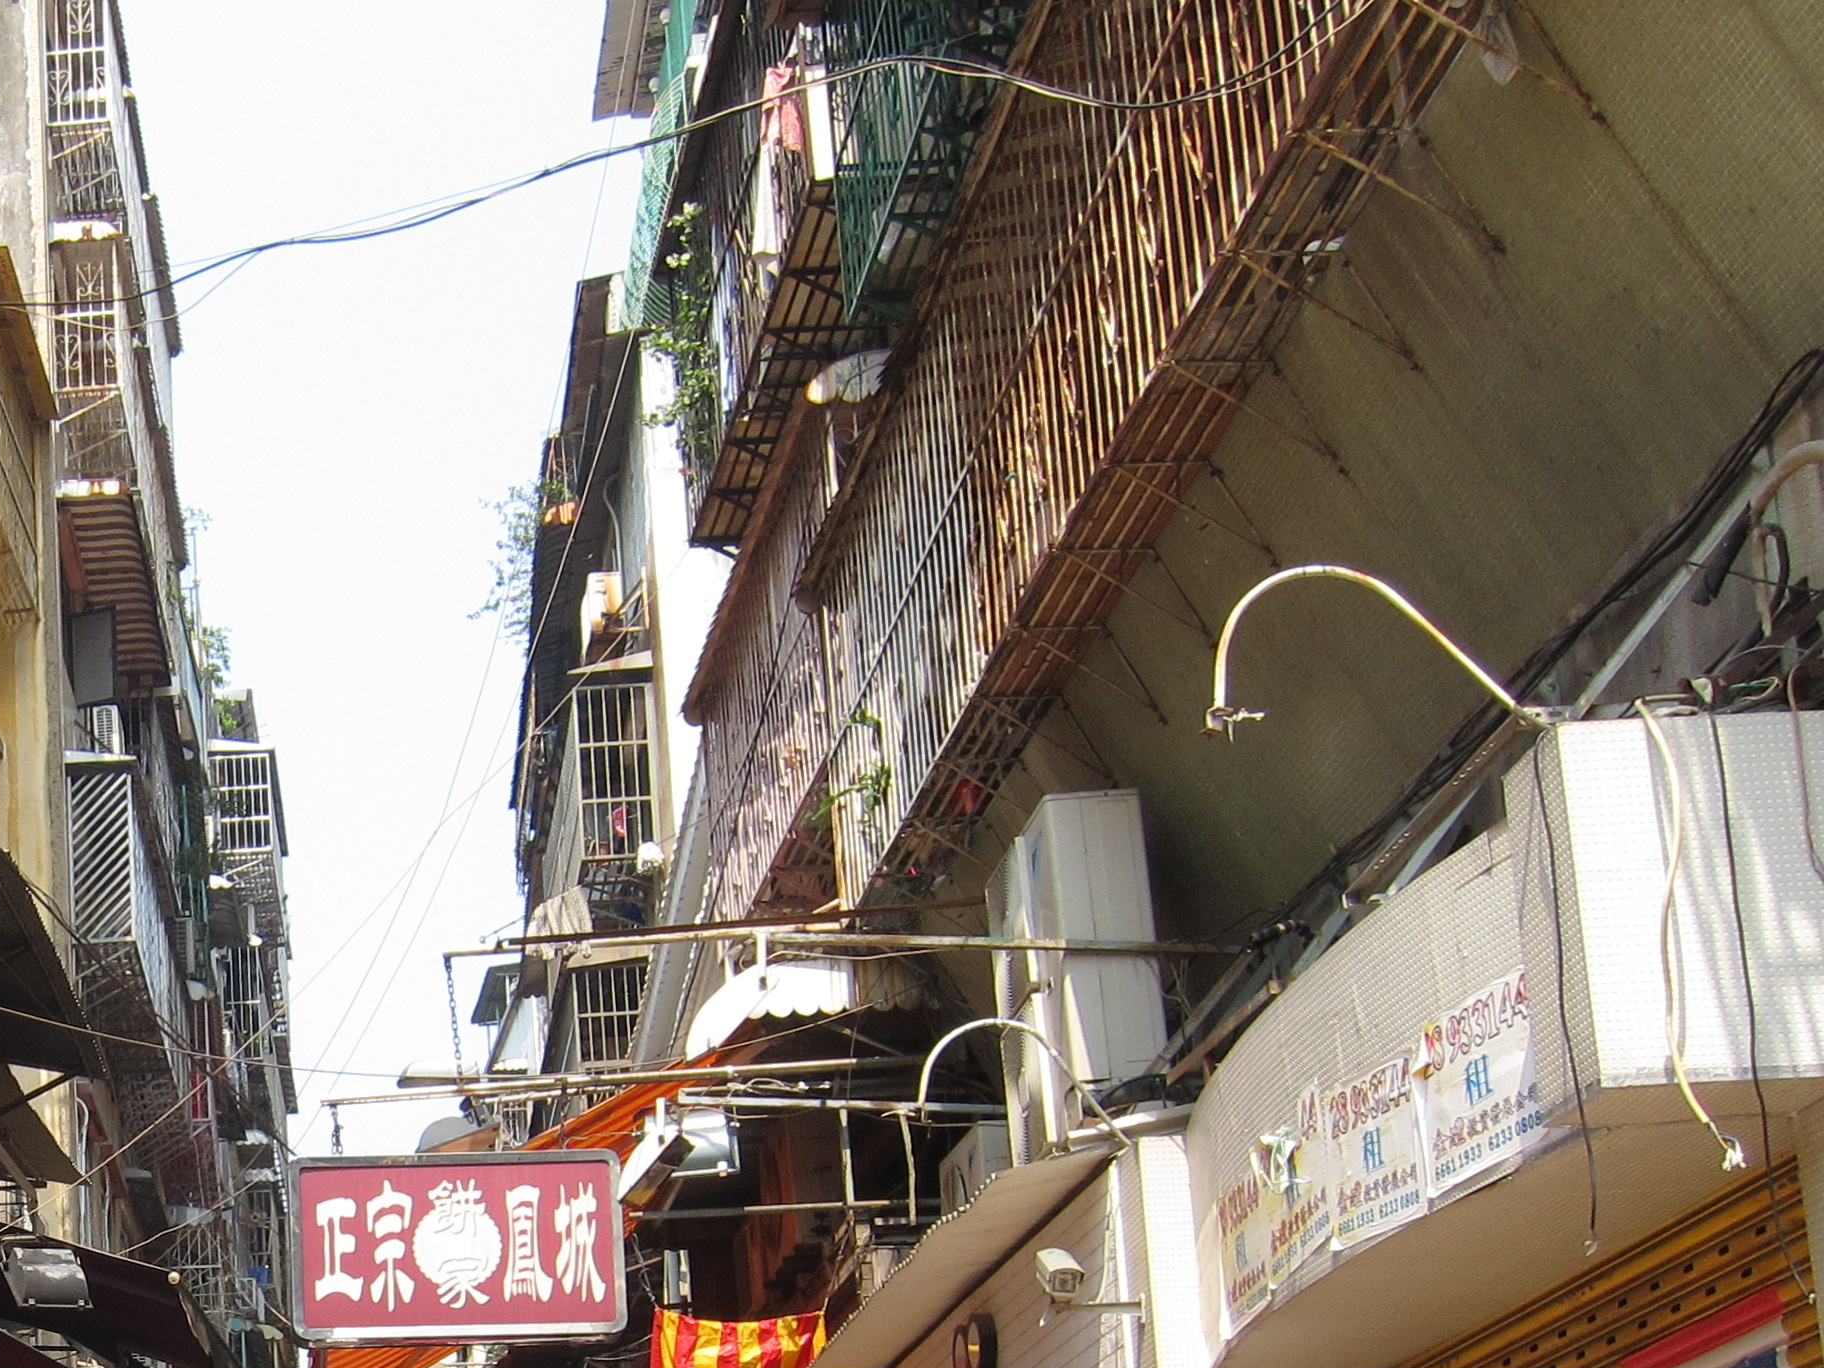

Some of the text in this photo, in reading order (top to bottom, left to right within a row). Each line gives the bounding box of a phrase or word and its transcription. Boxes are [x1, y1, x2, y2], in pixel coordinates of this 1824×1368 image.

[1464, 1054, 1495, 1106] 租
[1362, 1126, 1386, 1173] 租
[314, 1179, 416, 1312] 正宗
[502, 1180, 606, 1304] 鳳城
